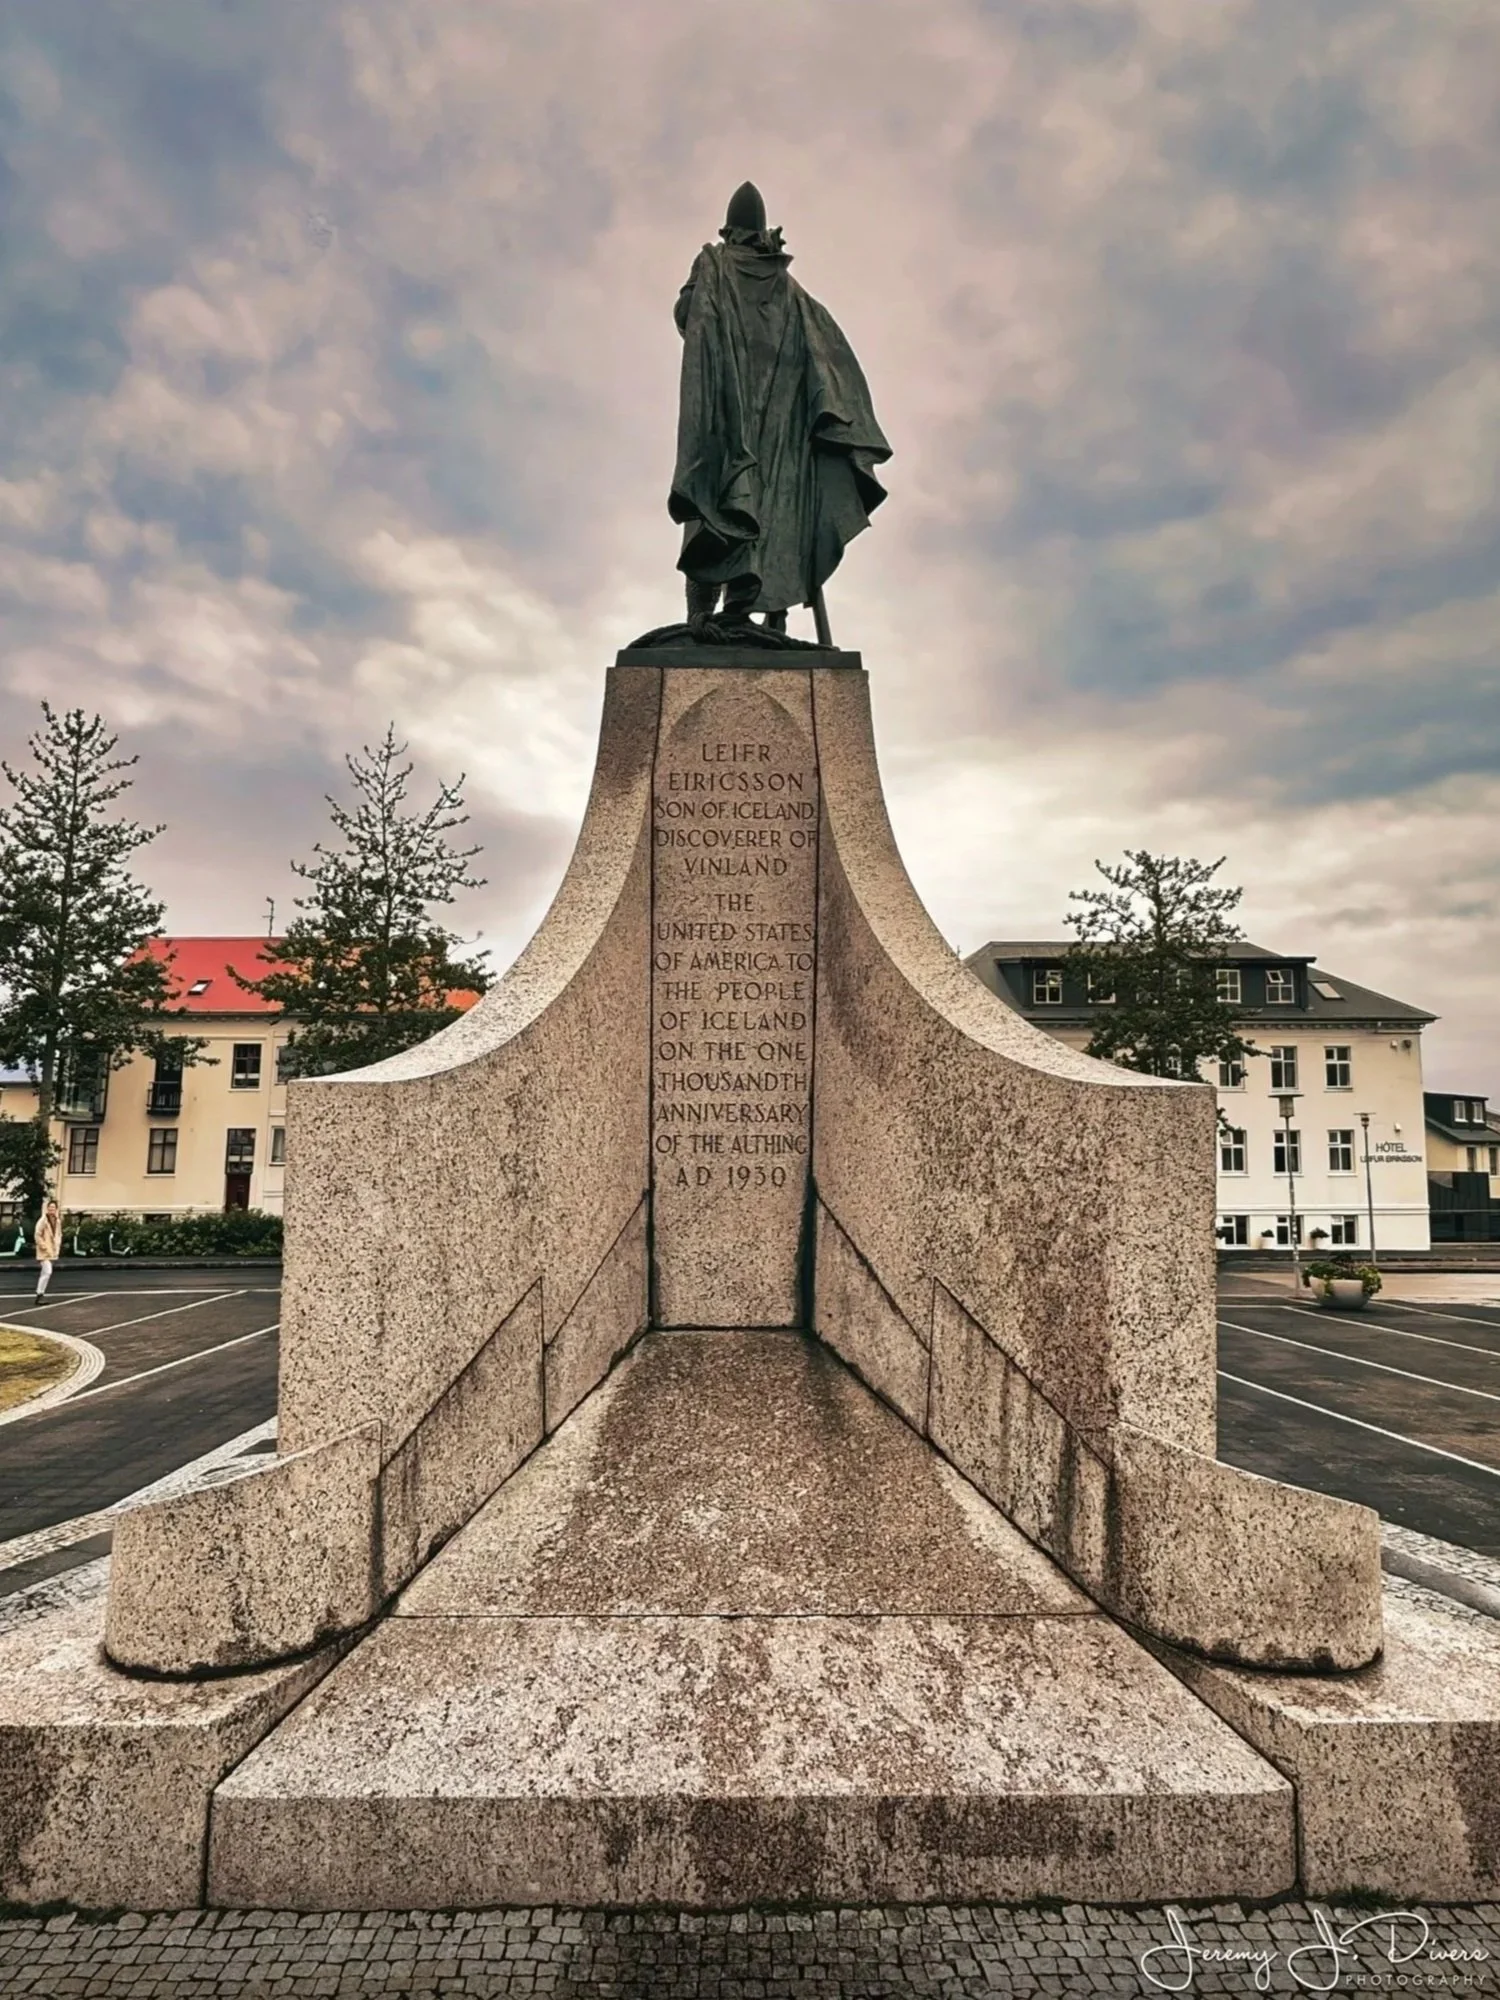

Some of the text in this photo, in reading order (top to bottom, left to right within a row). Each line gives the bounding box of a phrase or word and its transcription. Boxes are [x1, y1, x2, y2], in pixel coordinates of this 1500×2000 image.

[702, 743, 771, 762] LEIFR
[668, 772, 804, 792] EIRICSSON
[655, 801, 814, 820] SON OF ICELAND
[655, 829, 818, 848] DISCOVERER OF
[684, 857, 788, 876] VINLAND
[714, 893, 755, 912] THE
[657, 922, 812, 941] UNITED STATES
[655, 952, 812, 971] OF AMERICA TO
[661, 981, 805, 1000] THE PEOPLE
[659, 1011, 806, 1030] OF ICELAND
[658, 1041, 808, 1061] ON THE ONE
[658, 1071, 807, 1092] THOUSANDTH
[656, 1102, 808, 1124] ANNIVERSARY
[655, 1134, 808, 1154] OF THE ALTHING
[728, 1165, 787, 1189] 1930
